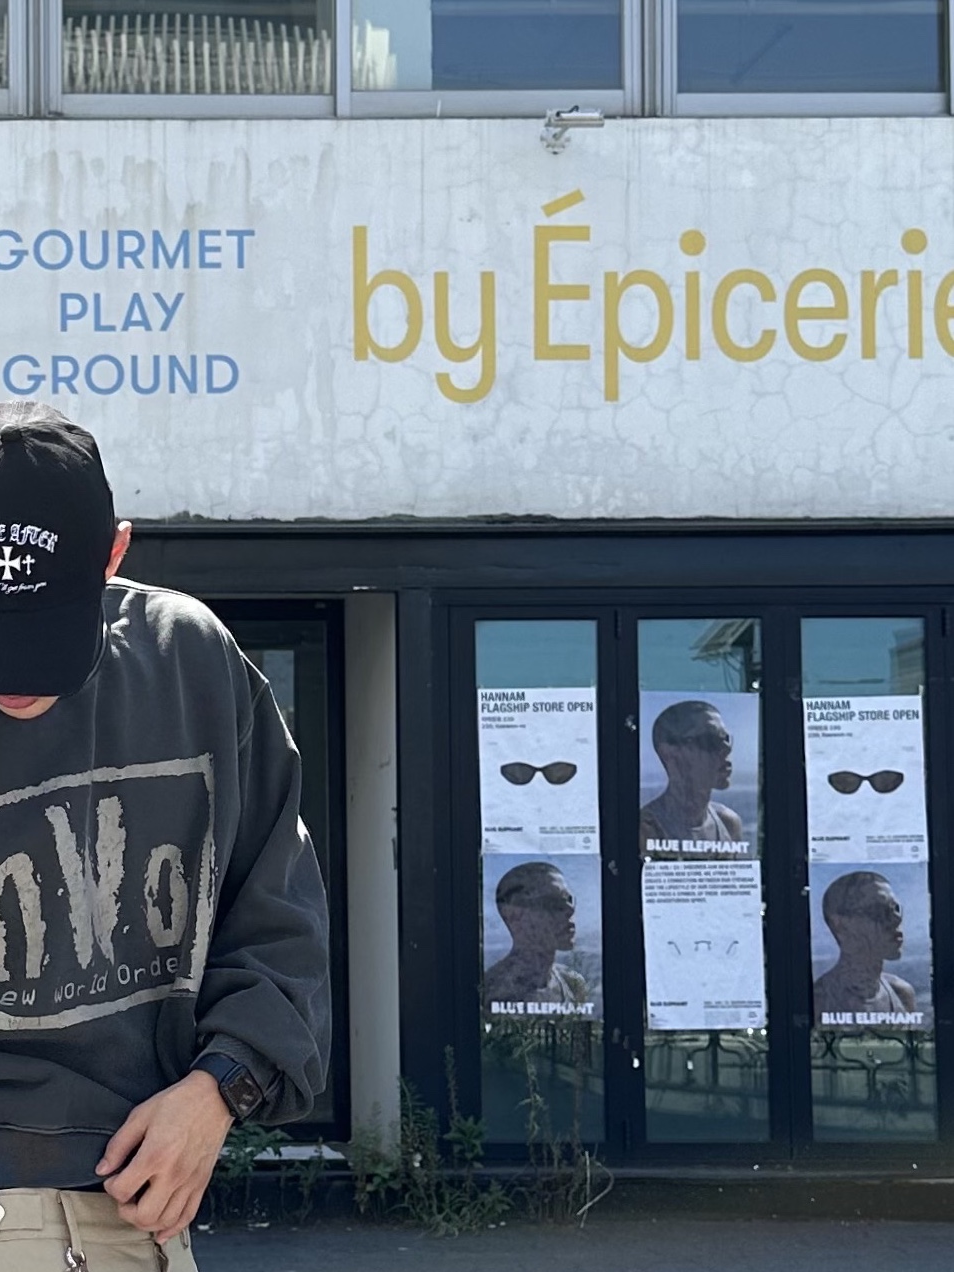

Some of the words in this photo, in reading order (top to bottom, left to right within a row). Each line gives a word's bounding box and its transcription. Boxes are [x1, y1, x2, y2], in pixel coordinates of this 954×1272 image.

[58, 291, 185, 333] PLAY
[352, 226, 496, 404] by
[1, 353, 240, 396] GROUND
[480, 691, 525, 701] HANNAM
[481, 702, 530, 713] FLAGSHIP
[532, 702, 564, 712] STORE
[567, 701, 594, 712] OPEN
[806, 700, 851, 710] HANNAM
[807, 711, 856, 722] FLAGSHIP
[858, 710, 890, 721] STORE
[892, 709, 920, 720] OPEN
[646, 838, 680, 851] BLUE
[681, 840, 750, 853] ELEPHANT
[117, 955, 179, 985] Orde
[491, 1001, 524, 1014] BLUE
[526, 1001, 594, 1014] ELEPHANT
[821, 1011, 853, 1024] BLUE
[855, 1011, 924, 1024] ELEPHANT
